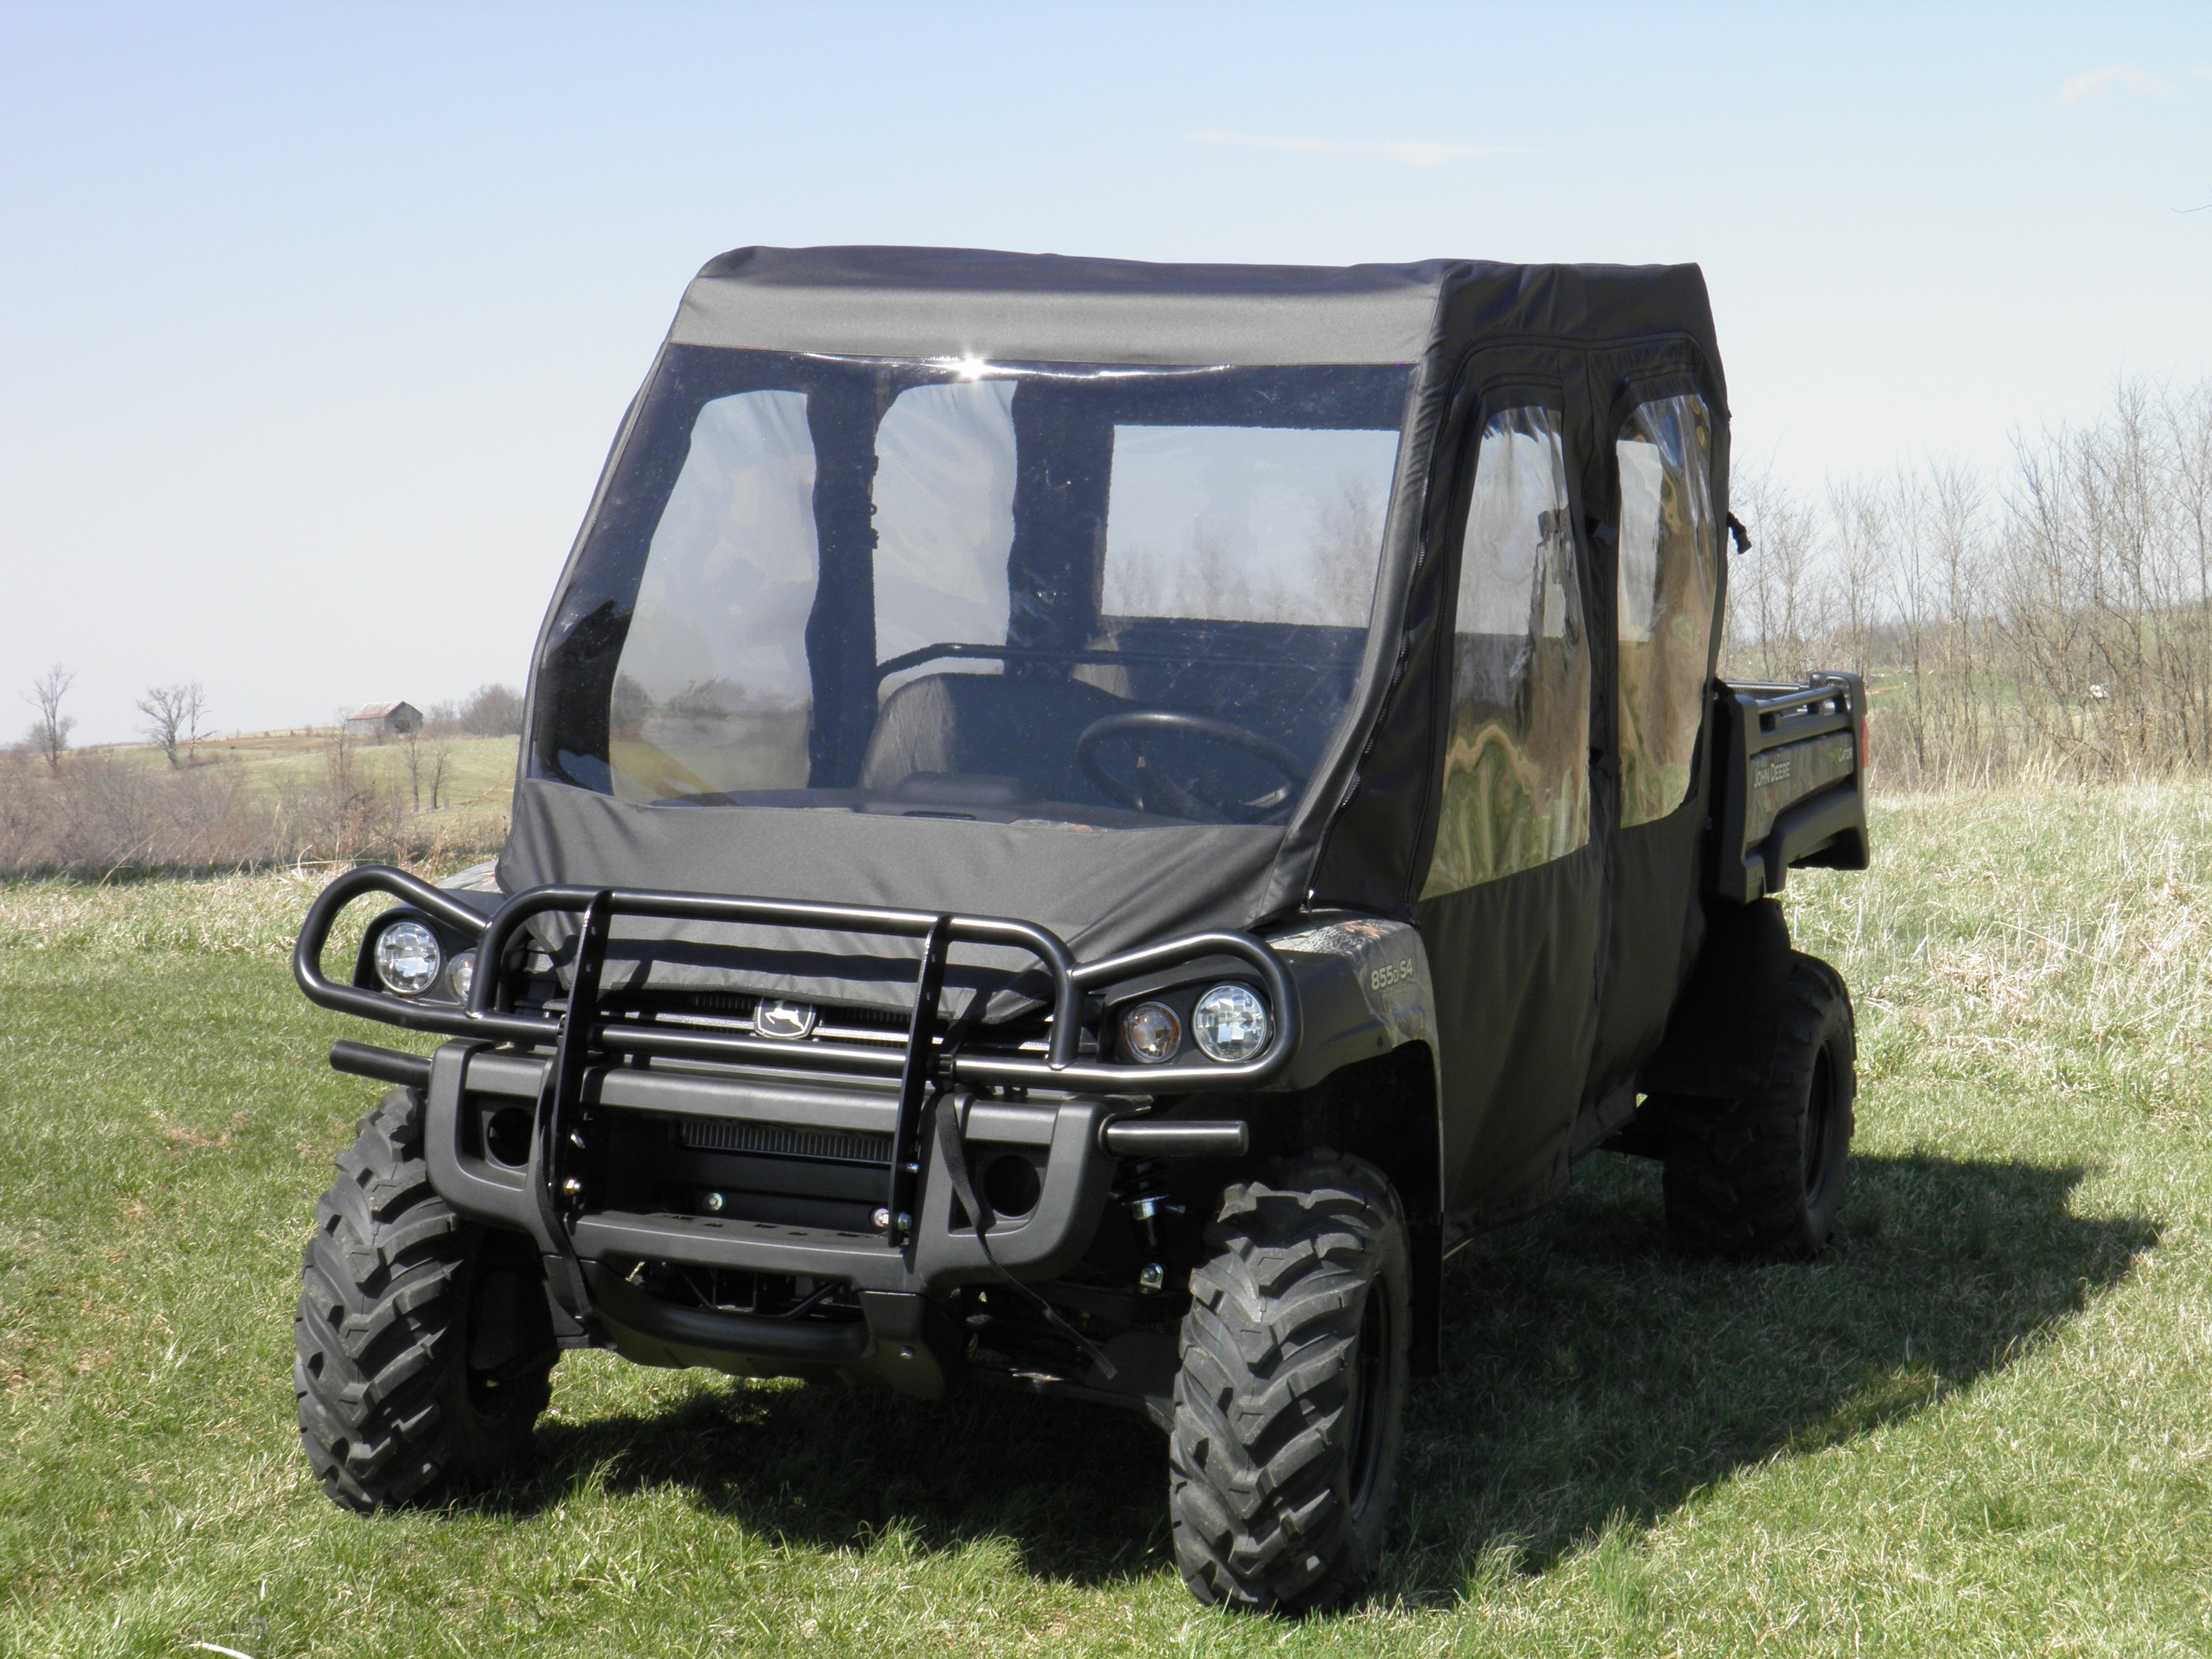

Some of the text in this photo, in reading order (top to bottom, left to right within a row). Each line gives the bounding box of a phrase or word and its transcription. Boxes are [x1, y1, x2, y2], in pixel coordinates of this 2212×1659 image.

[1754, 761, 1791, 789] JOHN DEERE
[1400, 958, 1413, 978] S4
